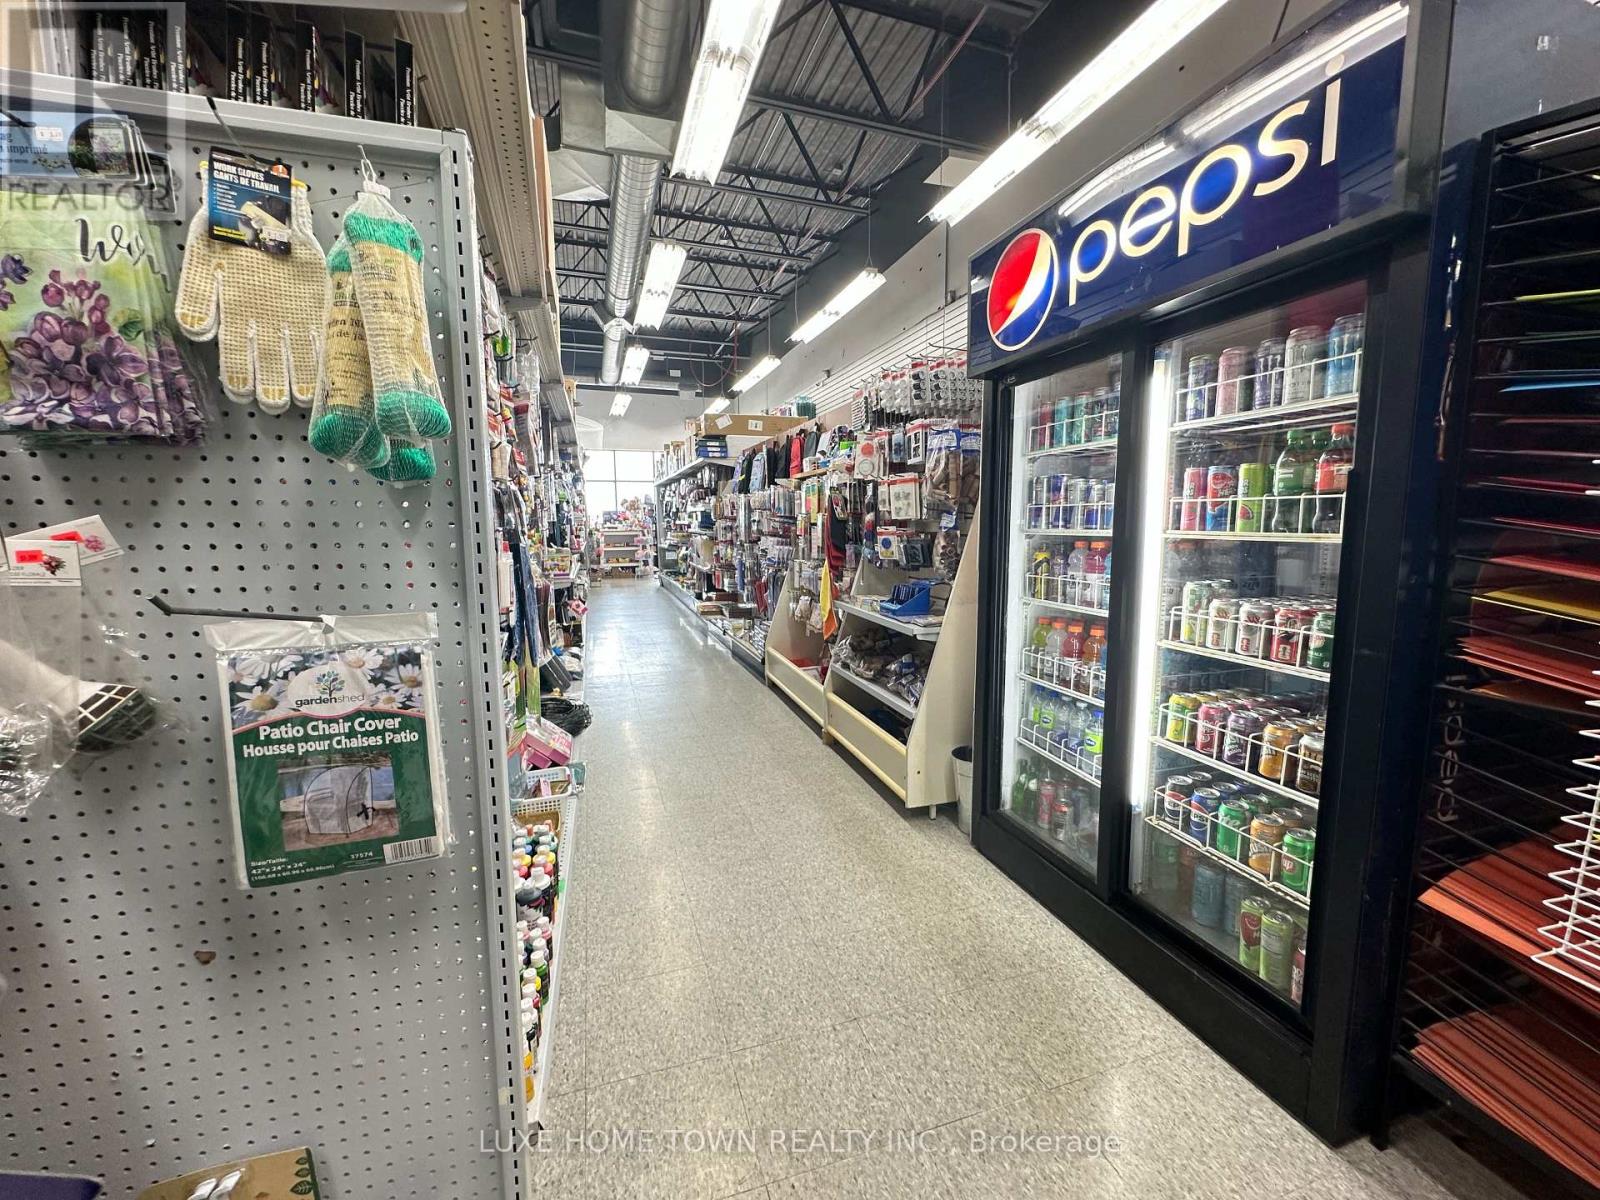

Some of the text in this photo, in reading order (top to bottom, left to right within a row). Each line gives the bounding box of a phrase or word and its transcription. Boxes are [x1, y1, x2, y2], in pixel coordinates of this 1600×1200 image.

[213, 161, 265, 182] WORK GLOVES
[213, 169, 280, 194] GANTS DE TRAVAIL
[1068, 53, 1345, 307] pepsi
[295, 693, 365, 708] gardenshed
[258, 717, 401, 740] Patio Chair Cover
[243, 730, 419, 758] Housse pour Chaises Patio
